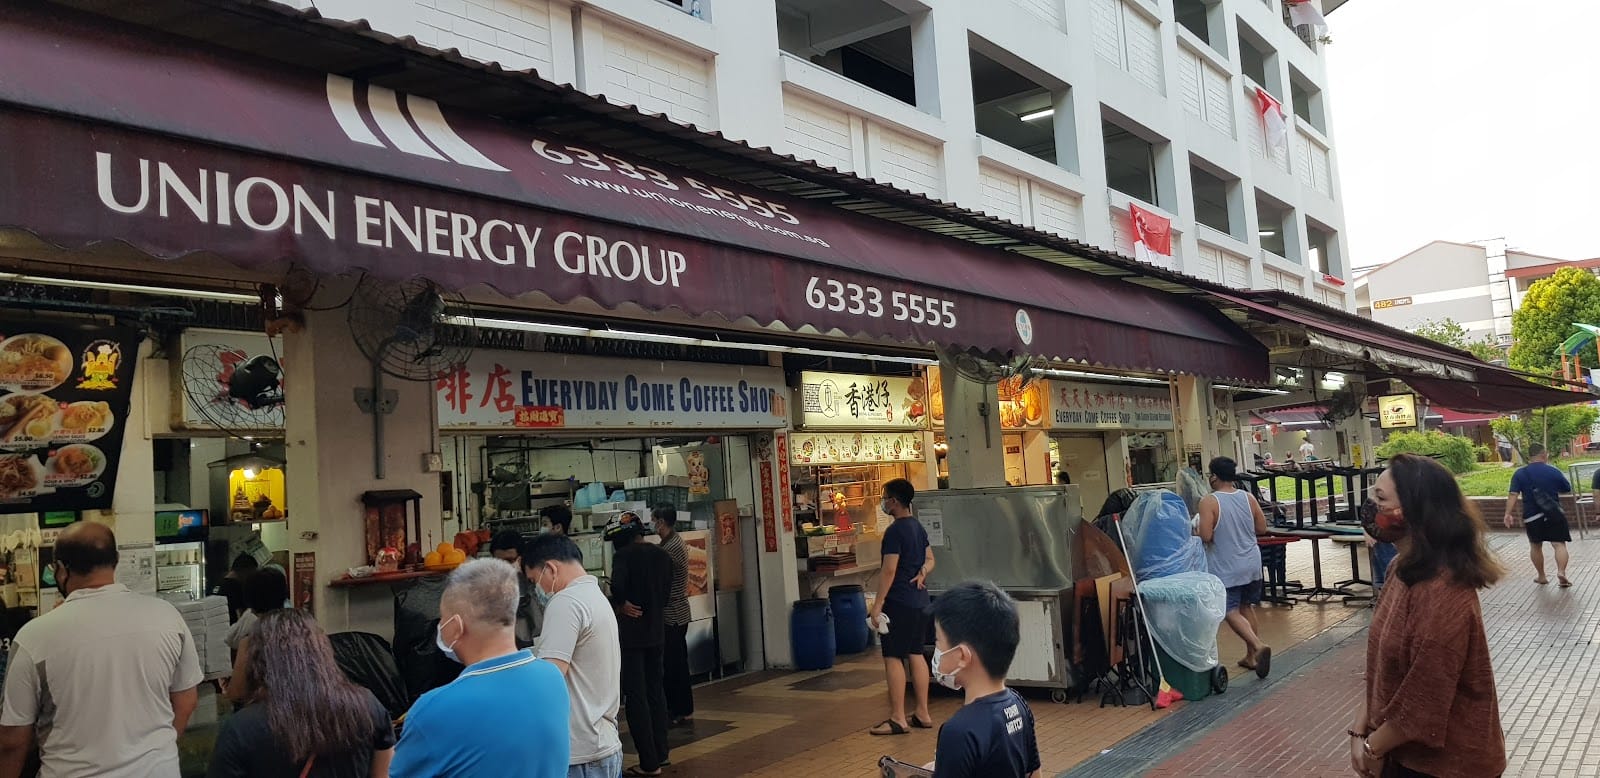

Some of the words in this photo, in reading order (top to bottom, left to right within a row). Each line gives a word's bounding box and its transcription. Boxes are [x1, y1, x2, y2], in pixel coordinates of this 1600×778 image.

[531, 139, 679, 191] 6333
[683, 176, 800, 225] 5555
[95, 151, 336, 240] UNION
[354, 195, 542, 268] ENERGY
[553, 231, 687, 287] GROUP
[563, 174, 831, 248] www.unionenergy.com.sg
[804, 276, 884, 319] 6333
[892, 292, 957, 330] 5555
[1374, 300, 1393, 309] 482
[521, 370, 618, 411] EVERYDAY
[625, 374, 674, 412] COME
[680, 377, 735, 412] COFFEE
[844, 380, 891, 419] 香港仔
[1055, 409, 1082, 423] EVERYDAY
[1084, 410, 1099, 424] COME
[1100, 411, 1118, 424] COFFEE
